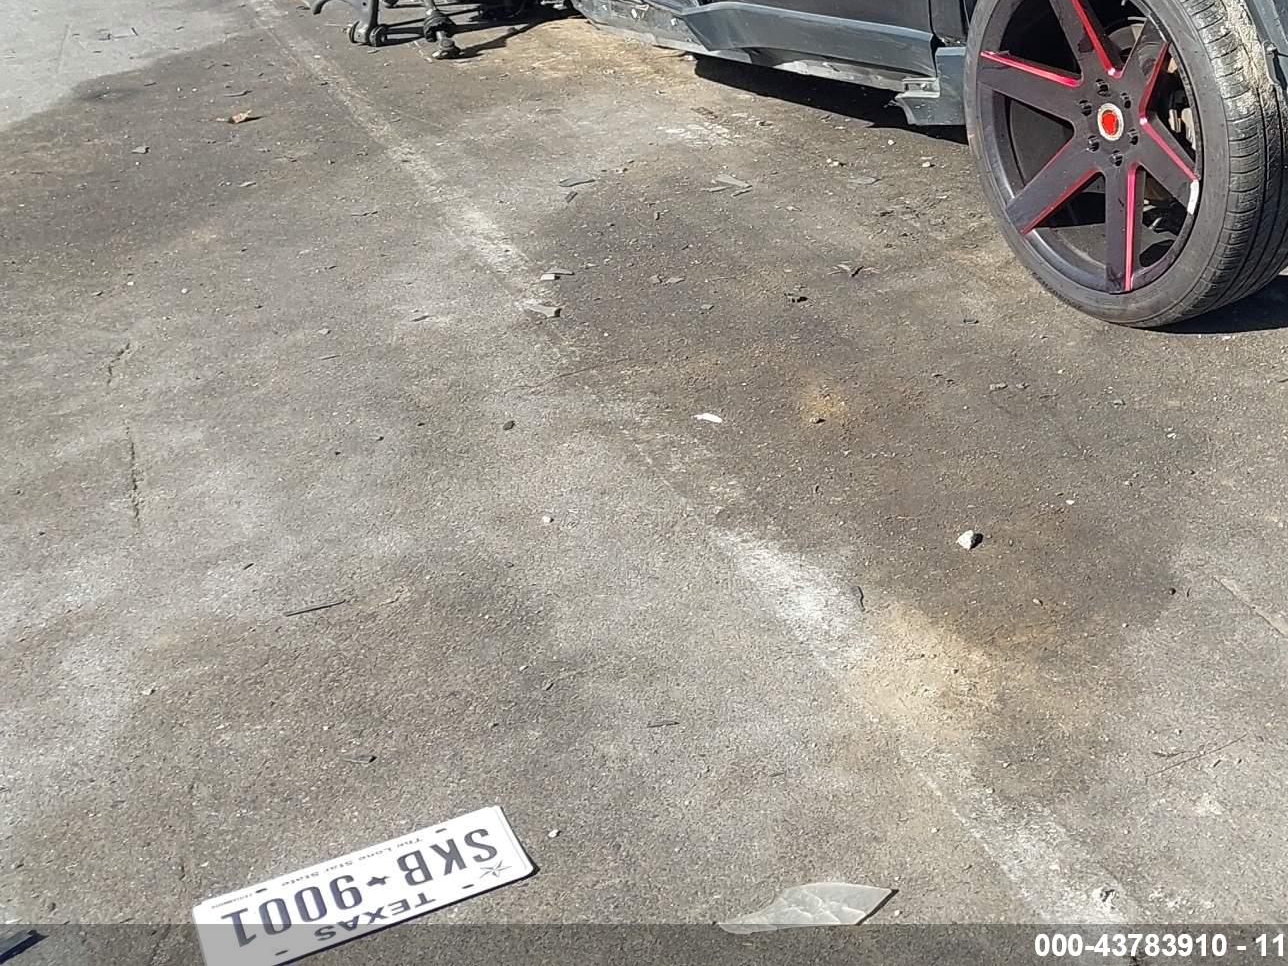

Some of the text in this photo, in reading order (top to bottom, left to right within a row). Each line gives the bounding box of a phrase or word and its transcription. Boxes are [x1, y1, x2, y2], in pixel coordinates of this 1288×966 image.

[357, 847, 393, 861] Lone
[322, 859, 354, 872] Star
[281, 870, 319, 886] State
[314, 891, 437, 942] TEXAS
